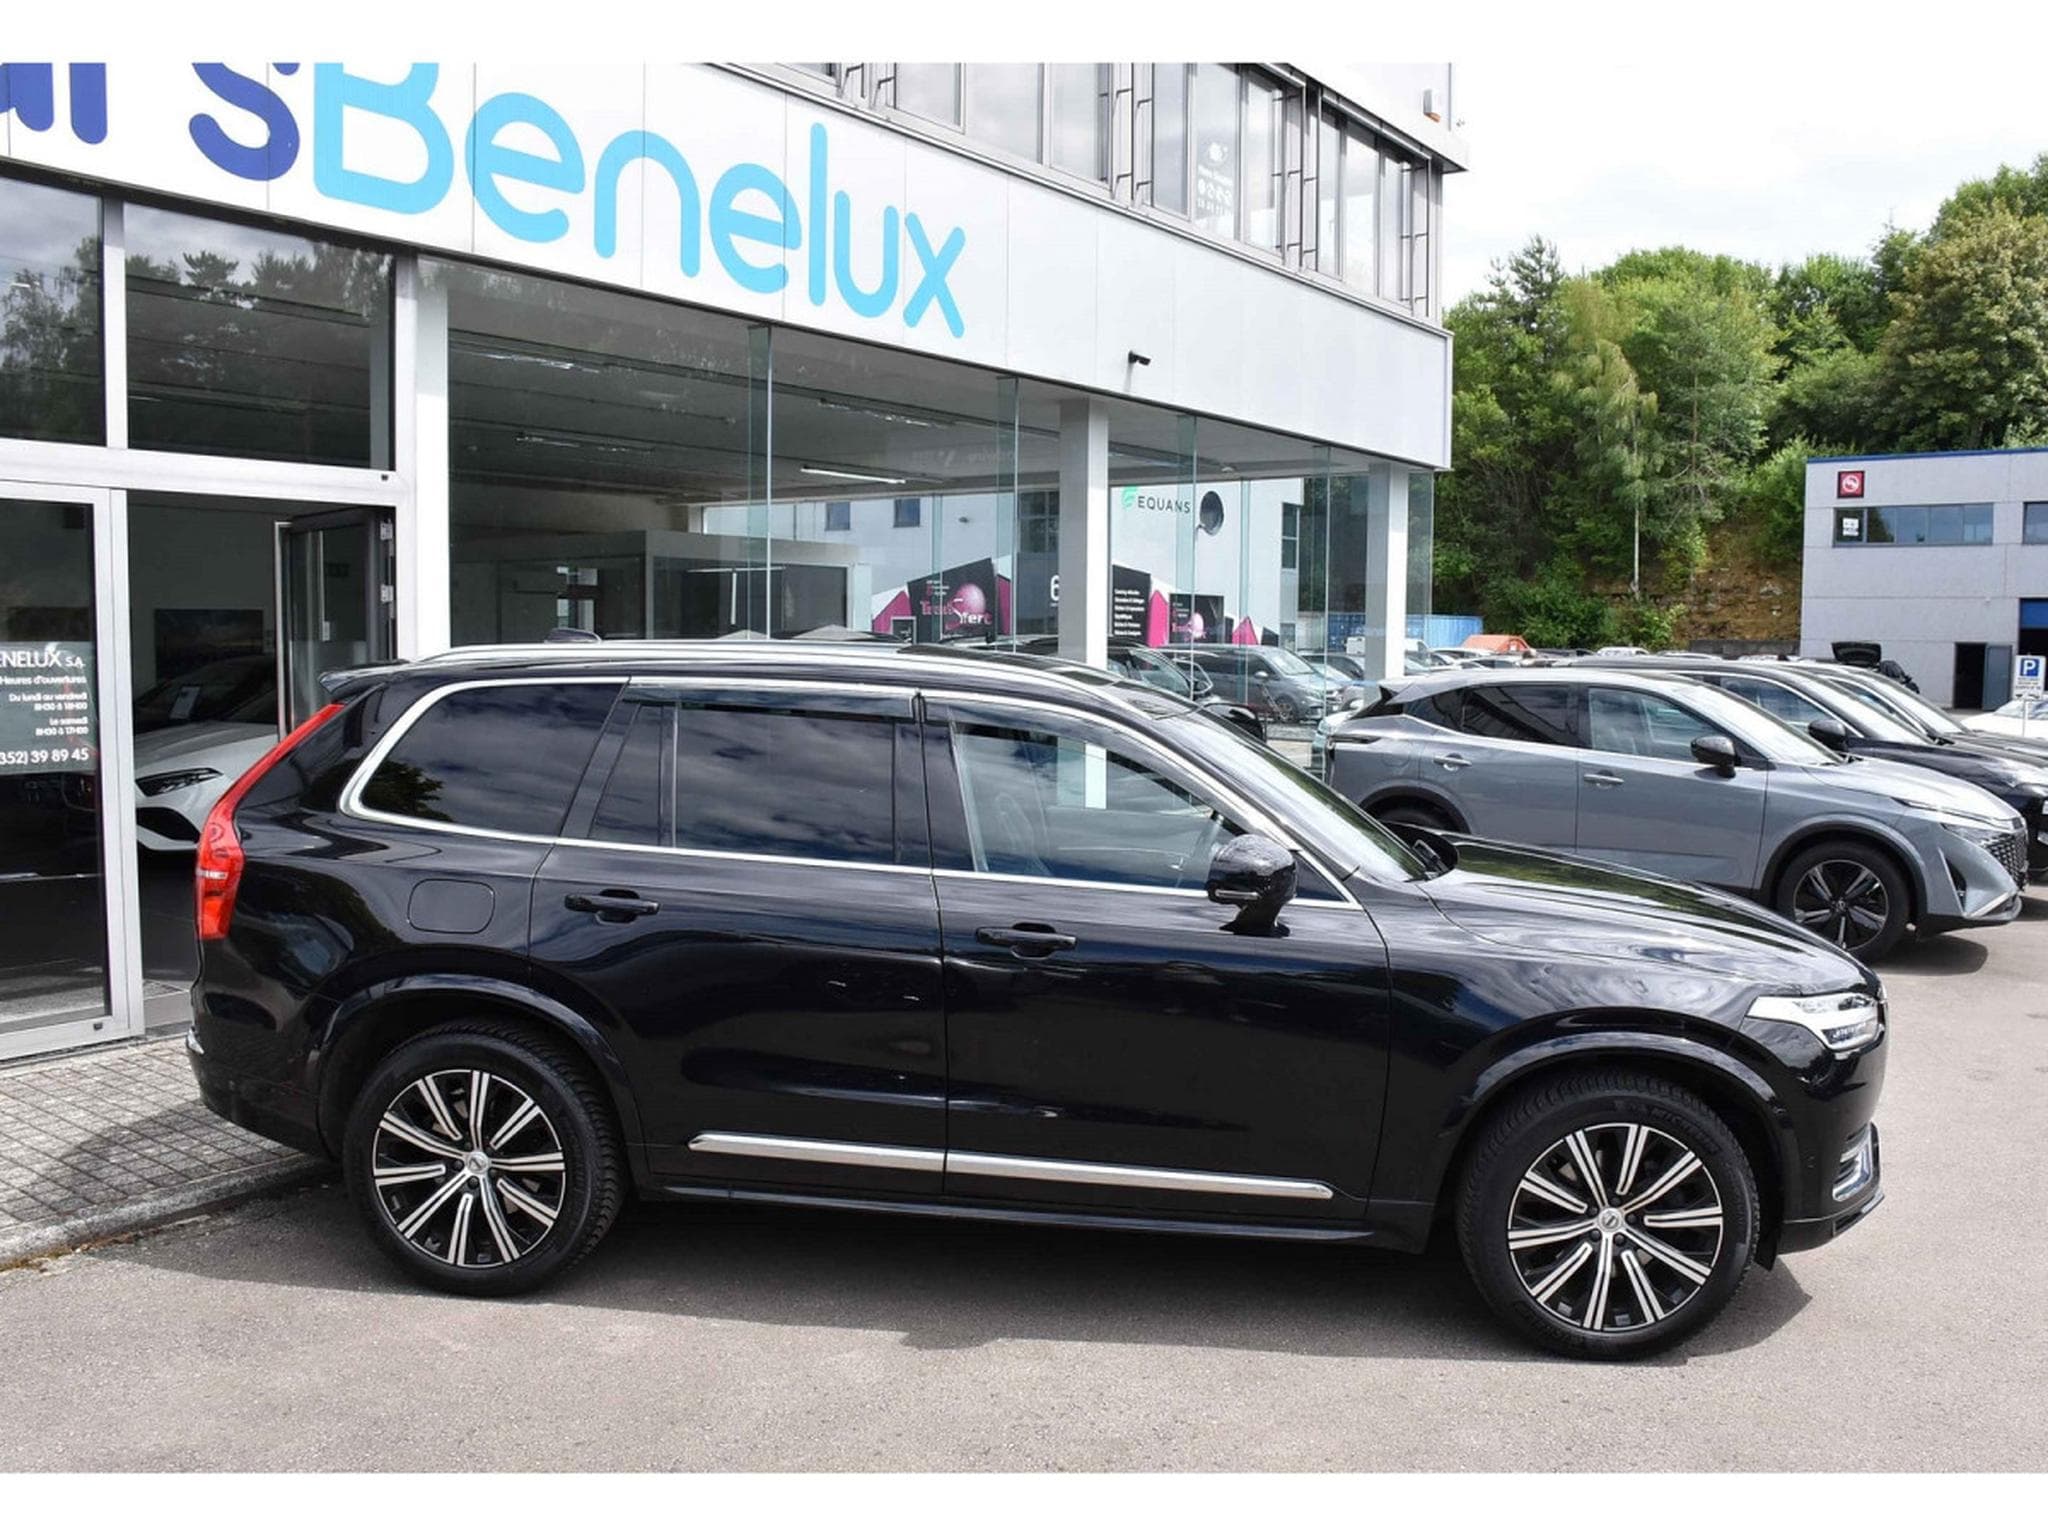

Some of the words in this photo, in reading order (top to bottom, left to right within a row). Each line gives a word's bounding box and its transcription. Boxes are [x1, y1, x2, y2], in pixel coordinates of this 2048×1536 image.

[1137, 495, 1191, 514] EQUANS
[0, 650, 62, 668] NELUX
[2023, 660, 2037, 675] P
[30, 751, 48, 763] 39
[51, 749, 69, 762] 89
[71, 748, 89, 760] 45
